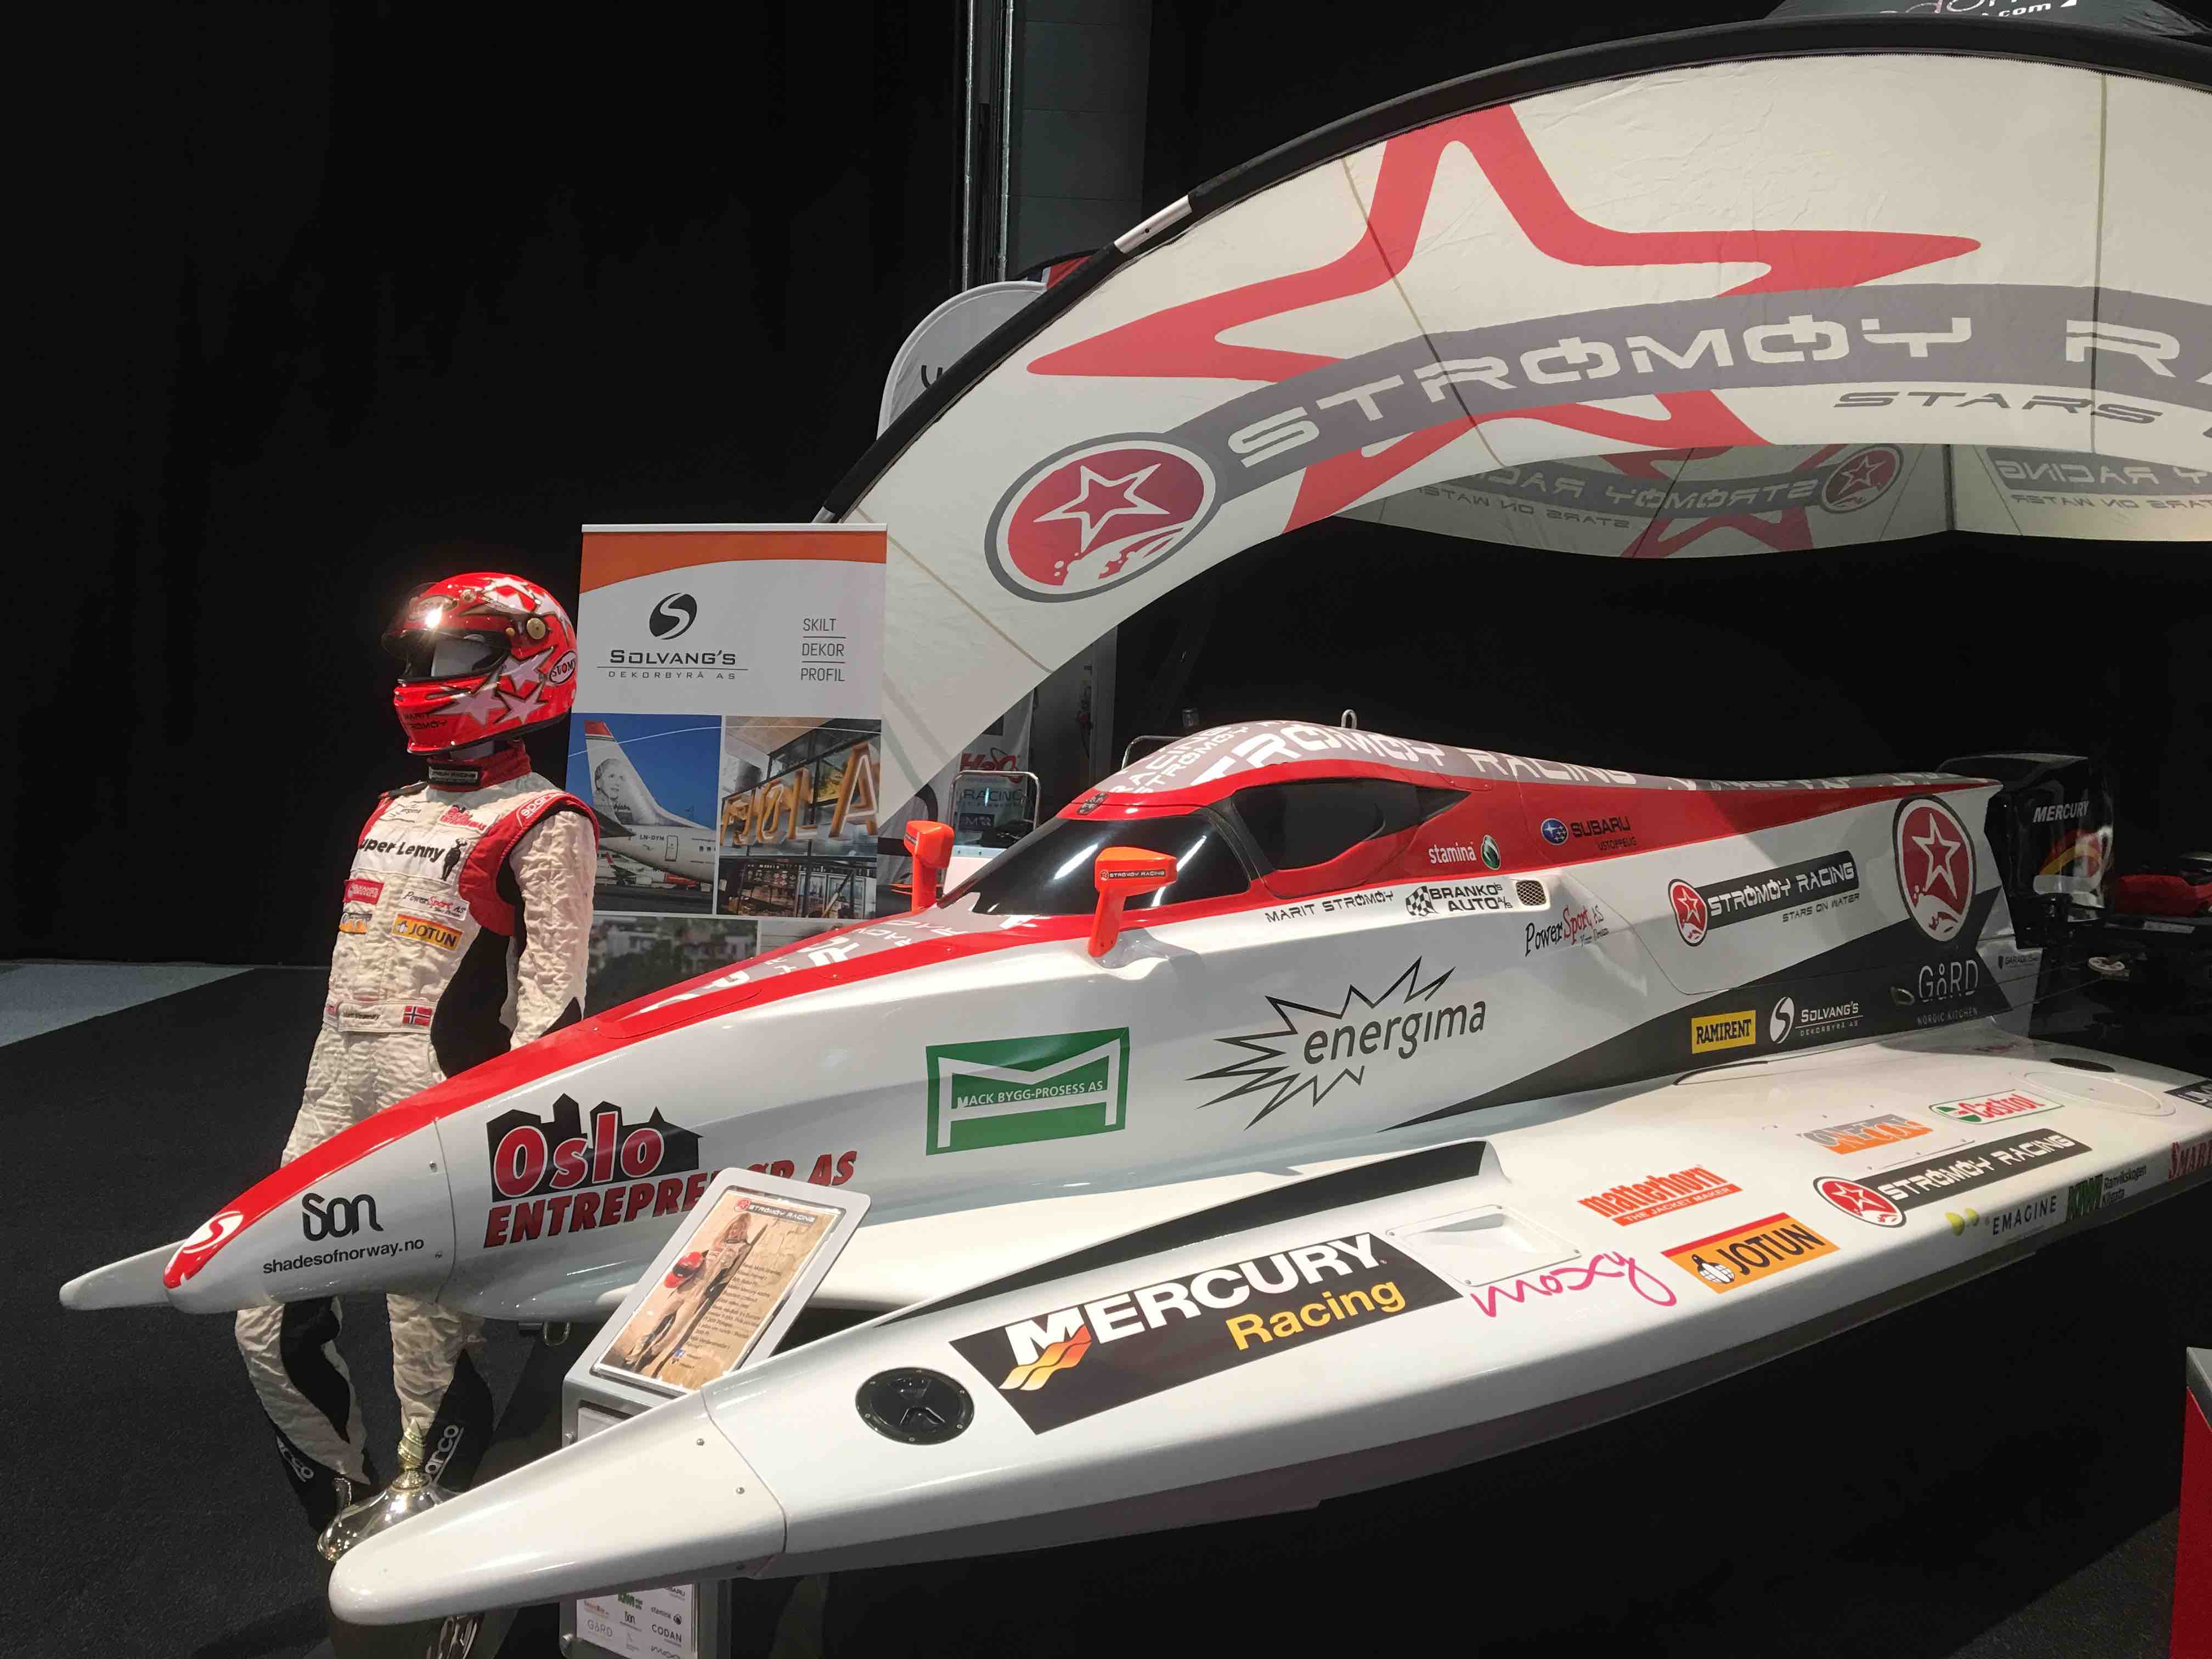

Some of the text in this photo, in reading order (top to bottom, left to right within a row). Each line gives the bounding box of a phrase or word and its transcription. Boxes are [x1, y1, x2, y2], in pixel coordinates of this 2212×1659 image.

[1833, 391, 2163, 424] STARS
[803, 618, 837, 631] SKILT
[802, 643, 845, 657] DEKOR
[800, 668, 845, 682] PROFIL
[2033, 800, 2089, 823] MERCURY
[1571, 816, 1631, 838] SUBARU
[359, 838, 445, 862] uper Lenny
[1428, 842, 1476, 865] stamina
[1796, 861, 1855, 892] RACING
[1265, 906, 1316, 923] MARIT
[1448, 898, 1499, 912] AUTO
[1782, 893, 1859, 923] STARS ON WATER
[409, 923, 457, 947] JOTUN
[1304, 1000, 1485, 1064] energima
[1696, 1019, 1752, 1045] RAMIRENT
[957, 1080, 1103, 1109] MACK BYGG-PROSESS AS
[1957, 1093, 2045, 1119] Castrol
[494, 1111, 664, 1197] Oslo
[1991, 1133, 2076, 1166] RACING
[1577, 1166, 1728, 1217] matterhorn
[1625, 1187, 1730, 1222] THE JACKET MAKER
[263, 1237, 424, 1274] shadesofnorway.no
[1715, 1224, 1826, 1276] JOTUN
[1470, 1250, 1677, 1317] moxy
[1003, 1232, 1383, 1366] MERCURY
[1225, 1280, 1408, 1351] Racing
[651, 1624, 682, 1643] CODAN
